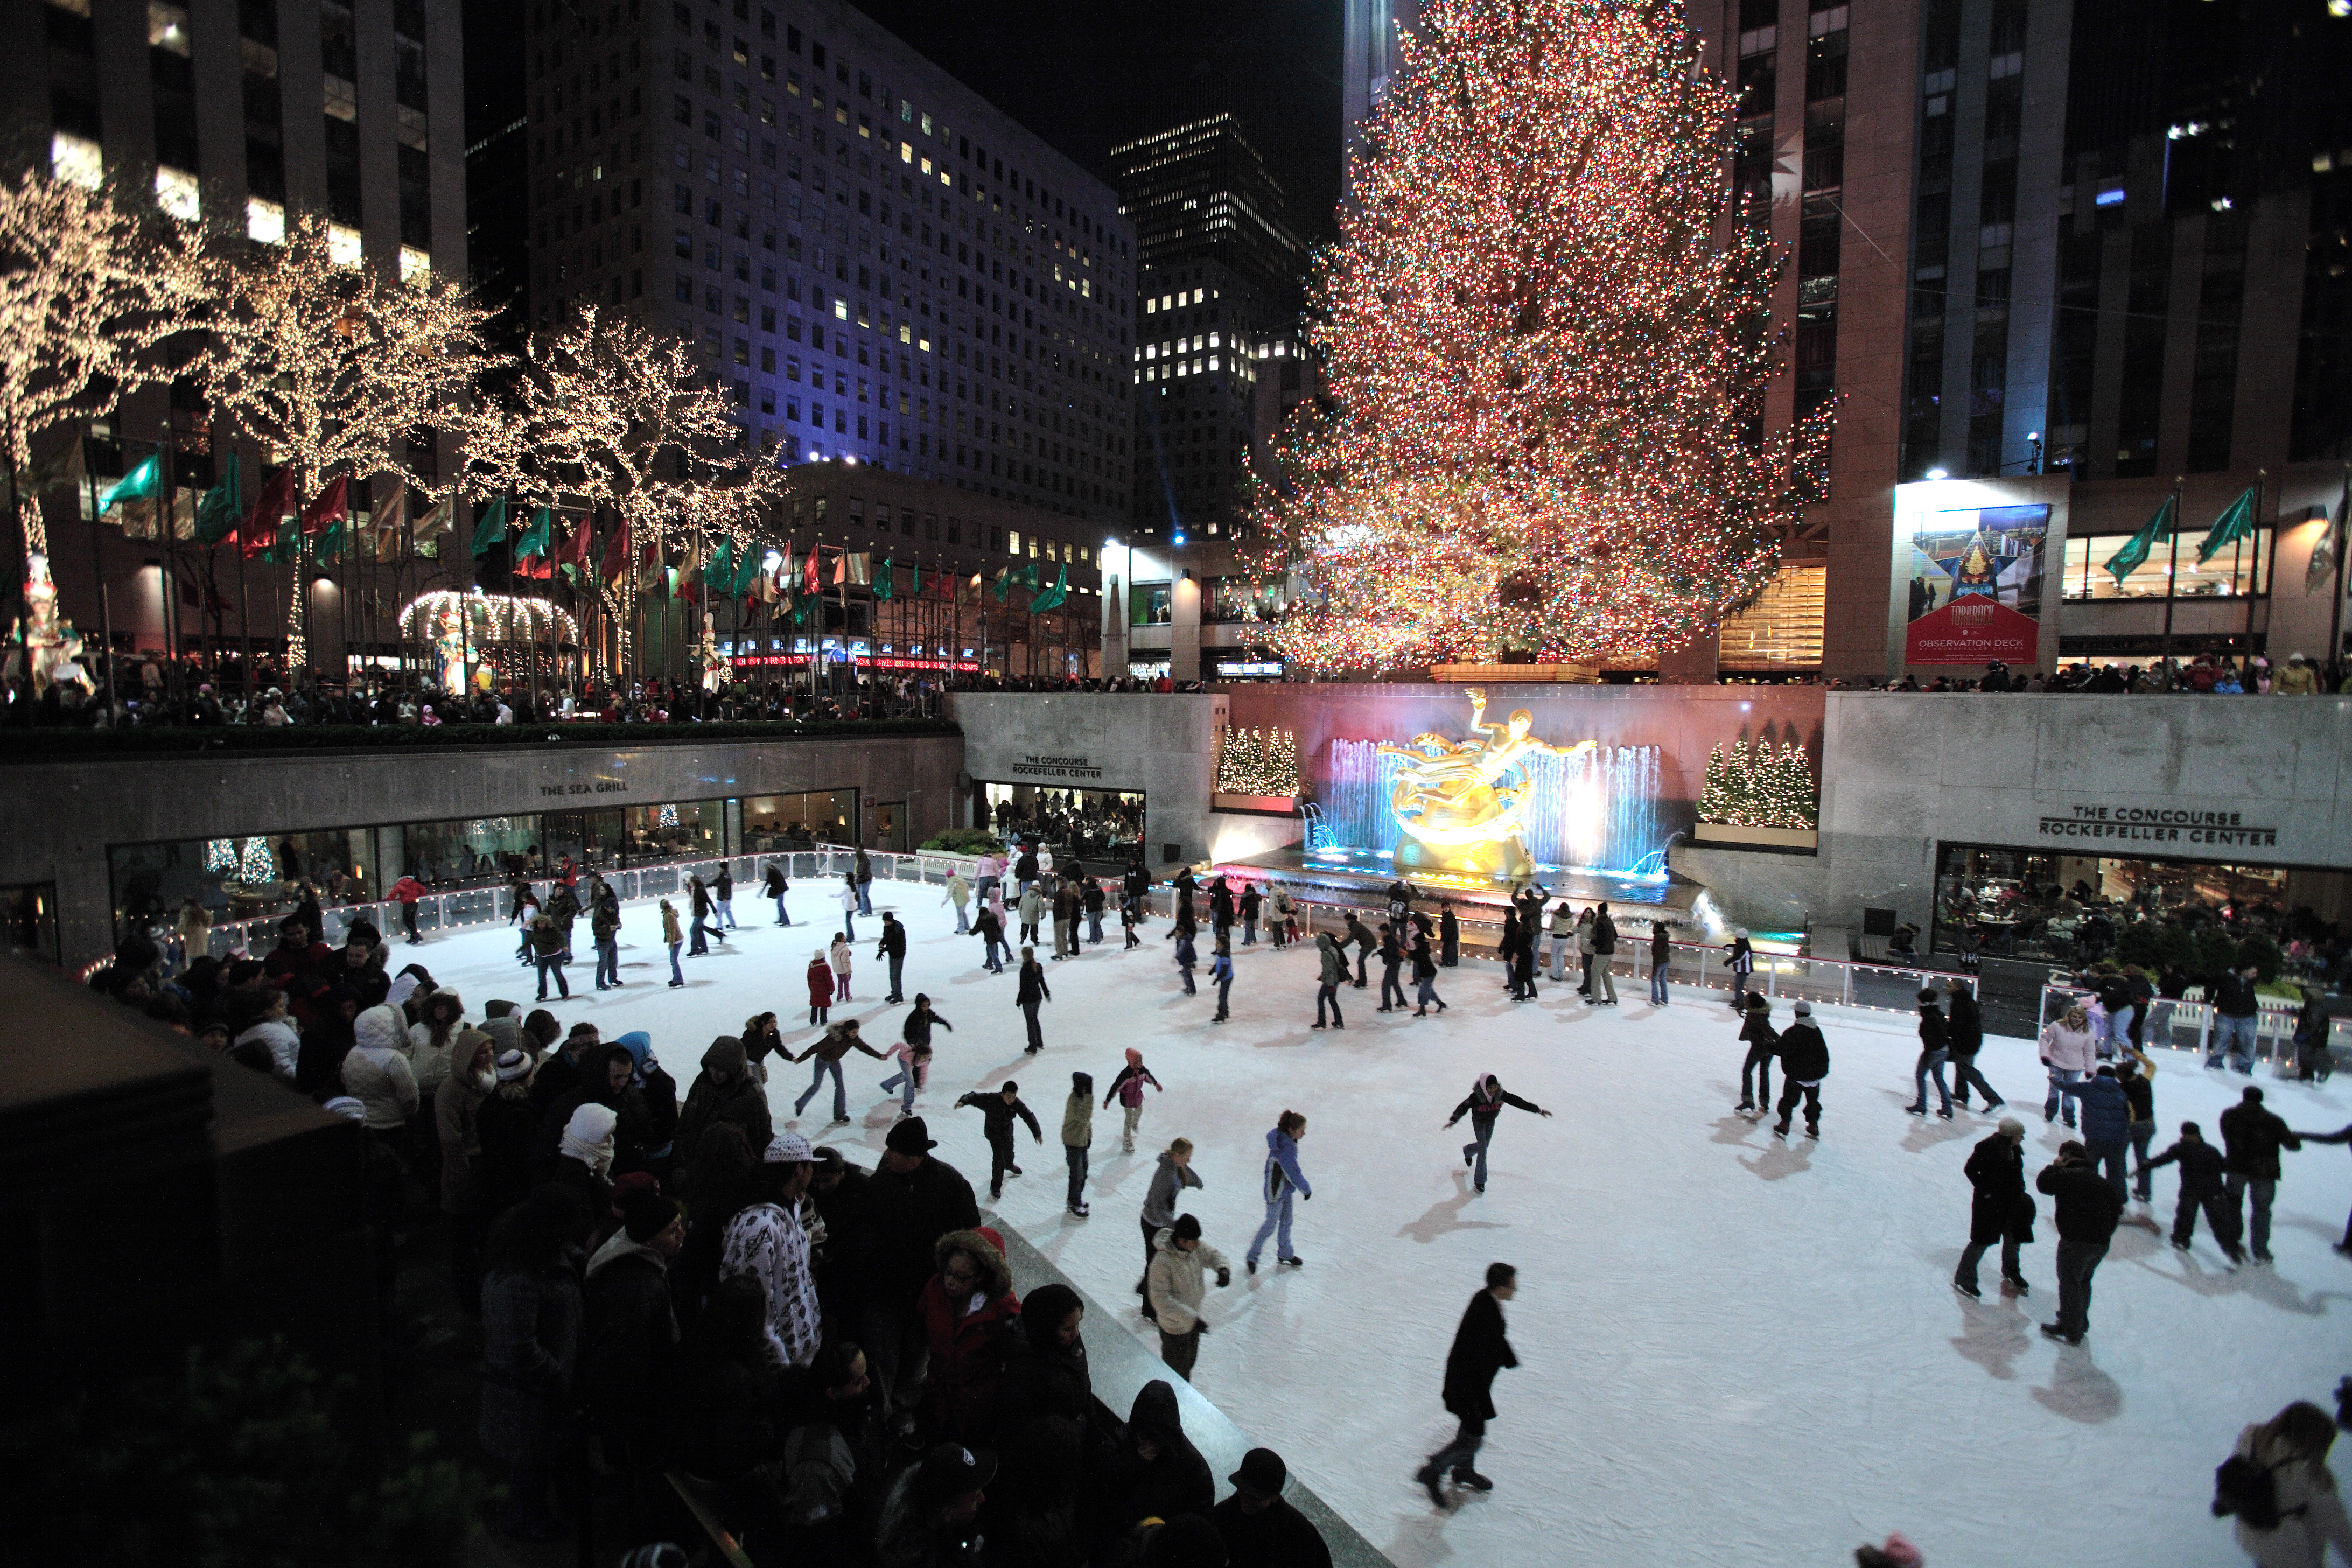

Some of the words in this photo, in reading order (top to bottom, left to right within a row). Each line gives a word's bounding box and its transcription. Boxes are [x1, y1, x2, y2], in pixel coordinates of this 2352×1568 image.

[1951, 605, 1966, 626] TOP
[1972, 604, 1995, 625] ROCK
[1994, 639, 2024, 647] DECK
[1025, 755, 1039, 764] THE
[1041, 756, 1088, 766] CONCOURSE
[1013, 766, 1066, 777] ROCKEFELLER
[1069, 769, 1101, 779] CENTER
[540, 785, 564, 796] THE
[569, 783, 592, 794] SEA
[596, 781, 629, 793] GRILL
[2073, 806, 2108, 820] THE
[2115, 808, 2242, 826] CONCOURSE
[2039, 822, 2179, 842] ROCKEFELLER
[2189, 829, 2276, 846] CENTER
